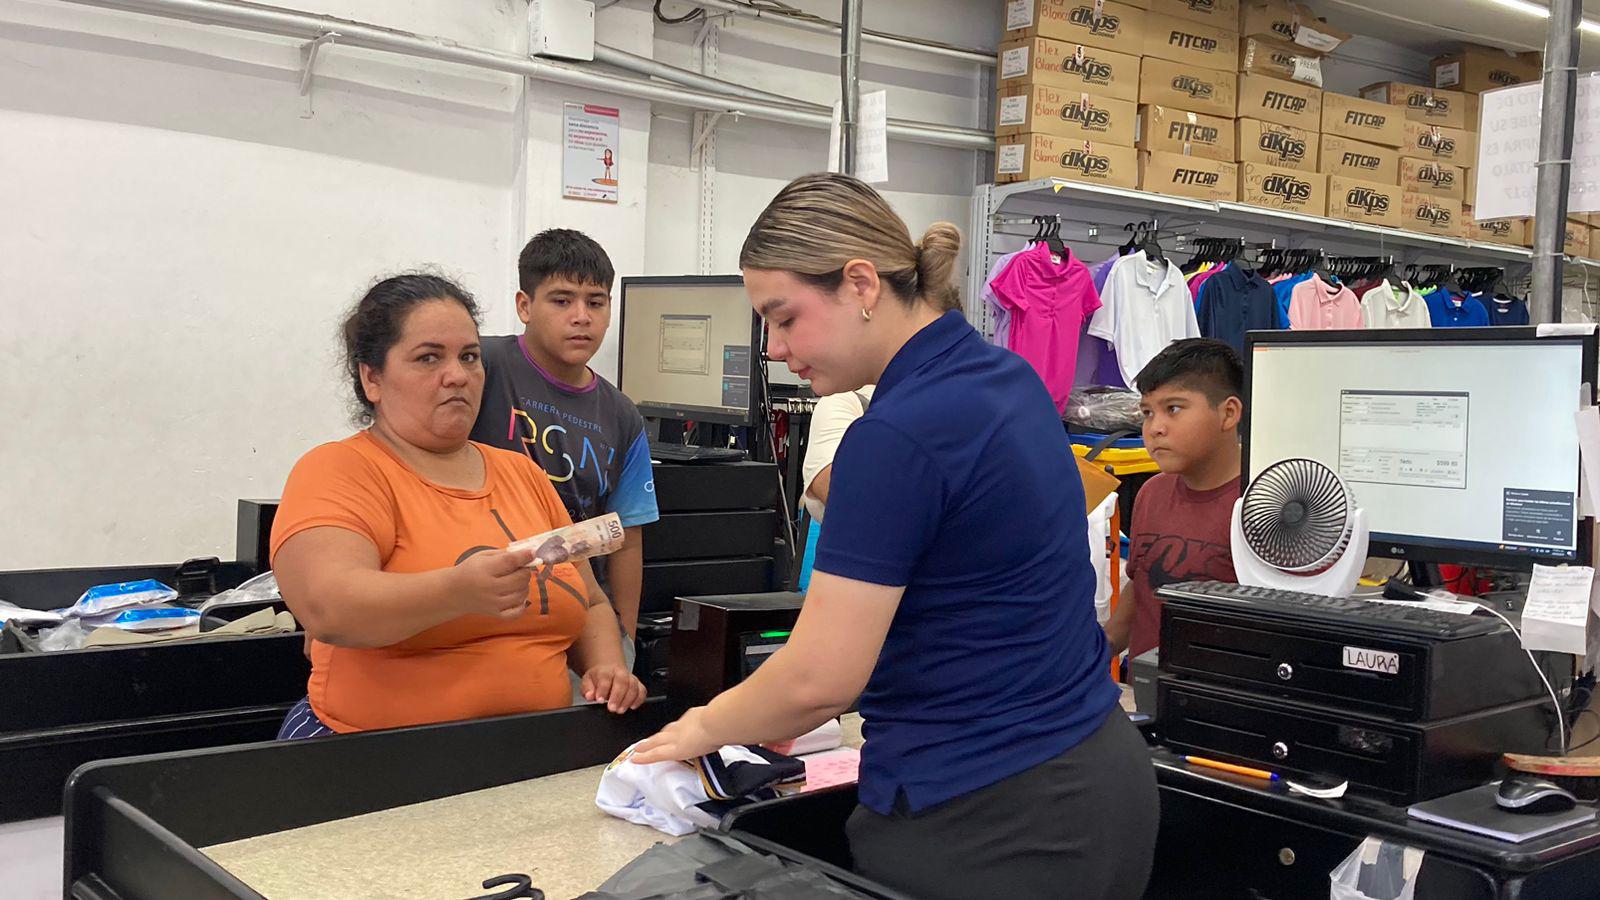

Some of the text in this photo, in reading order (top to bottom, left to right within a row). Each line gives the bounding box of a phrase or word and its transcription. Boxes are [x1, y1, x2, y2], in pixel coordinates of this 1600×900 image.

[1038, 40, 1058, 56] Flex
[1168, 30, 1218, 51] FITCAP
[1039, 88, 1060, 103] Flex
[1262, 91, 1307, 112] FITCAP
[1345, 110, 1386, 128] FITCAP
[1168, 121, 1218, 141] FITCAP
[1035, 136, 1053, 149] Flex
[1033, 149, 1060, 163] Blanco
[1341, 152, 1381, 169] FITCAP
[1172, 168, 1219, 185] FITCAP
[608, 519, 622, 540] 500
[1347, 648, 1398, 673] LAURA
